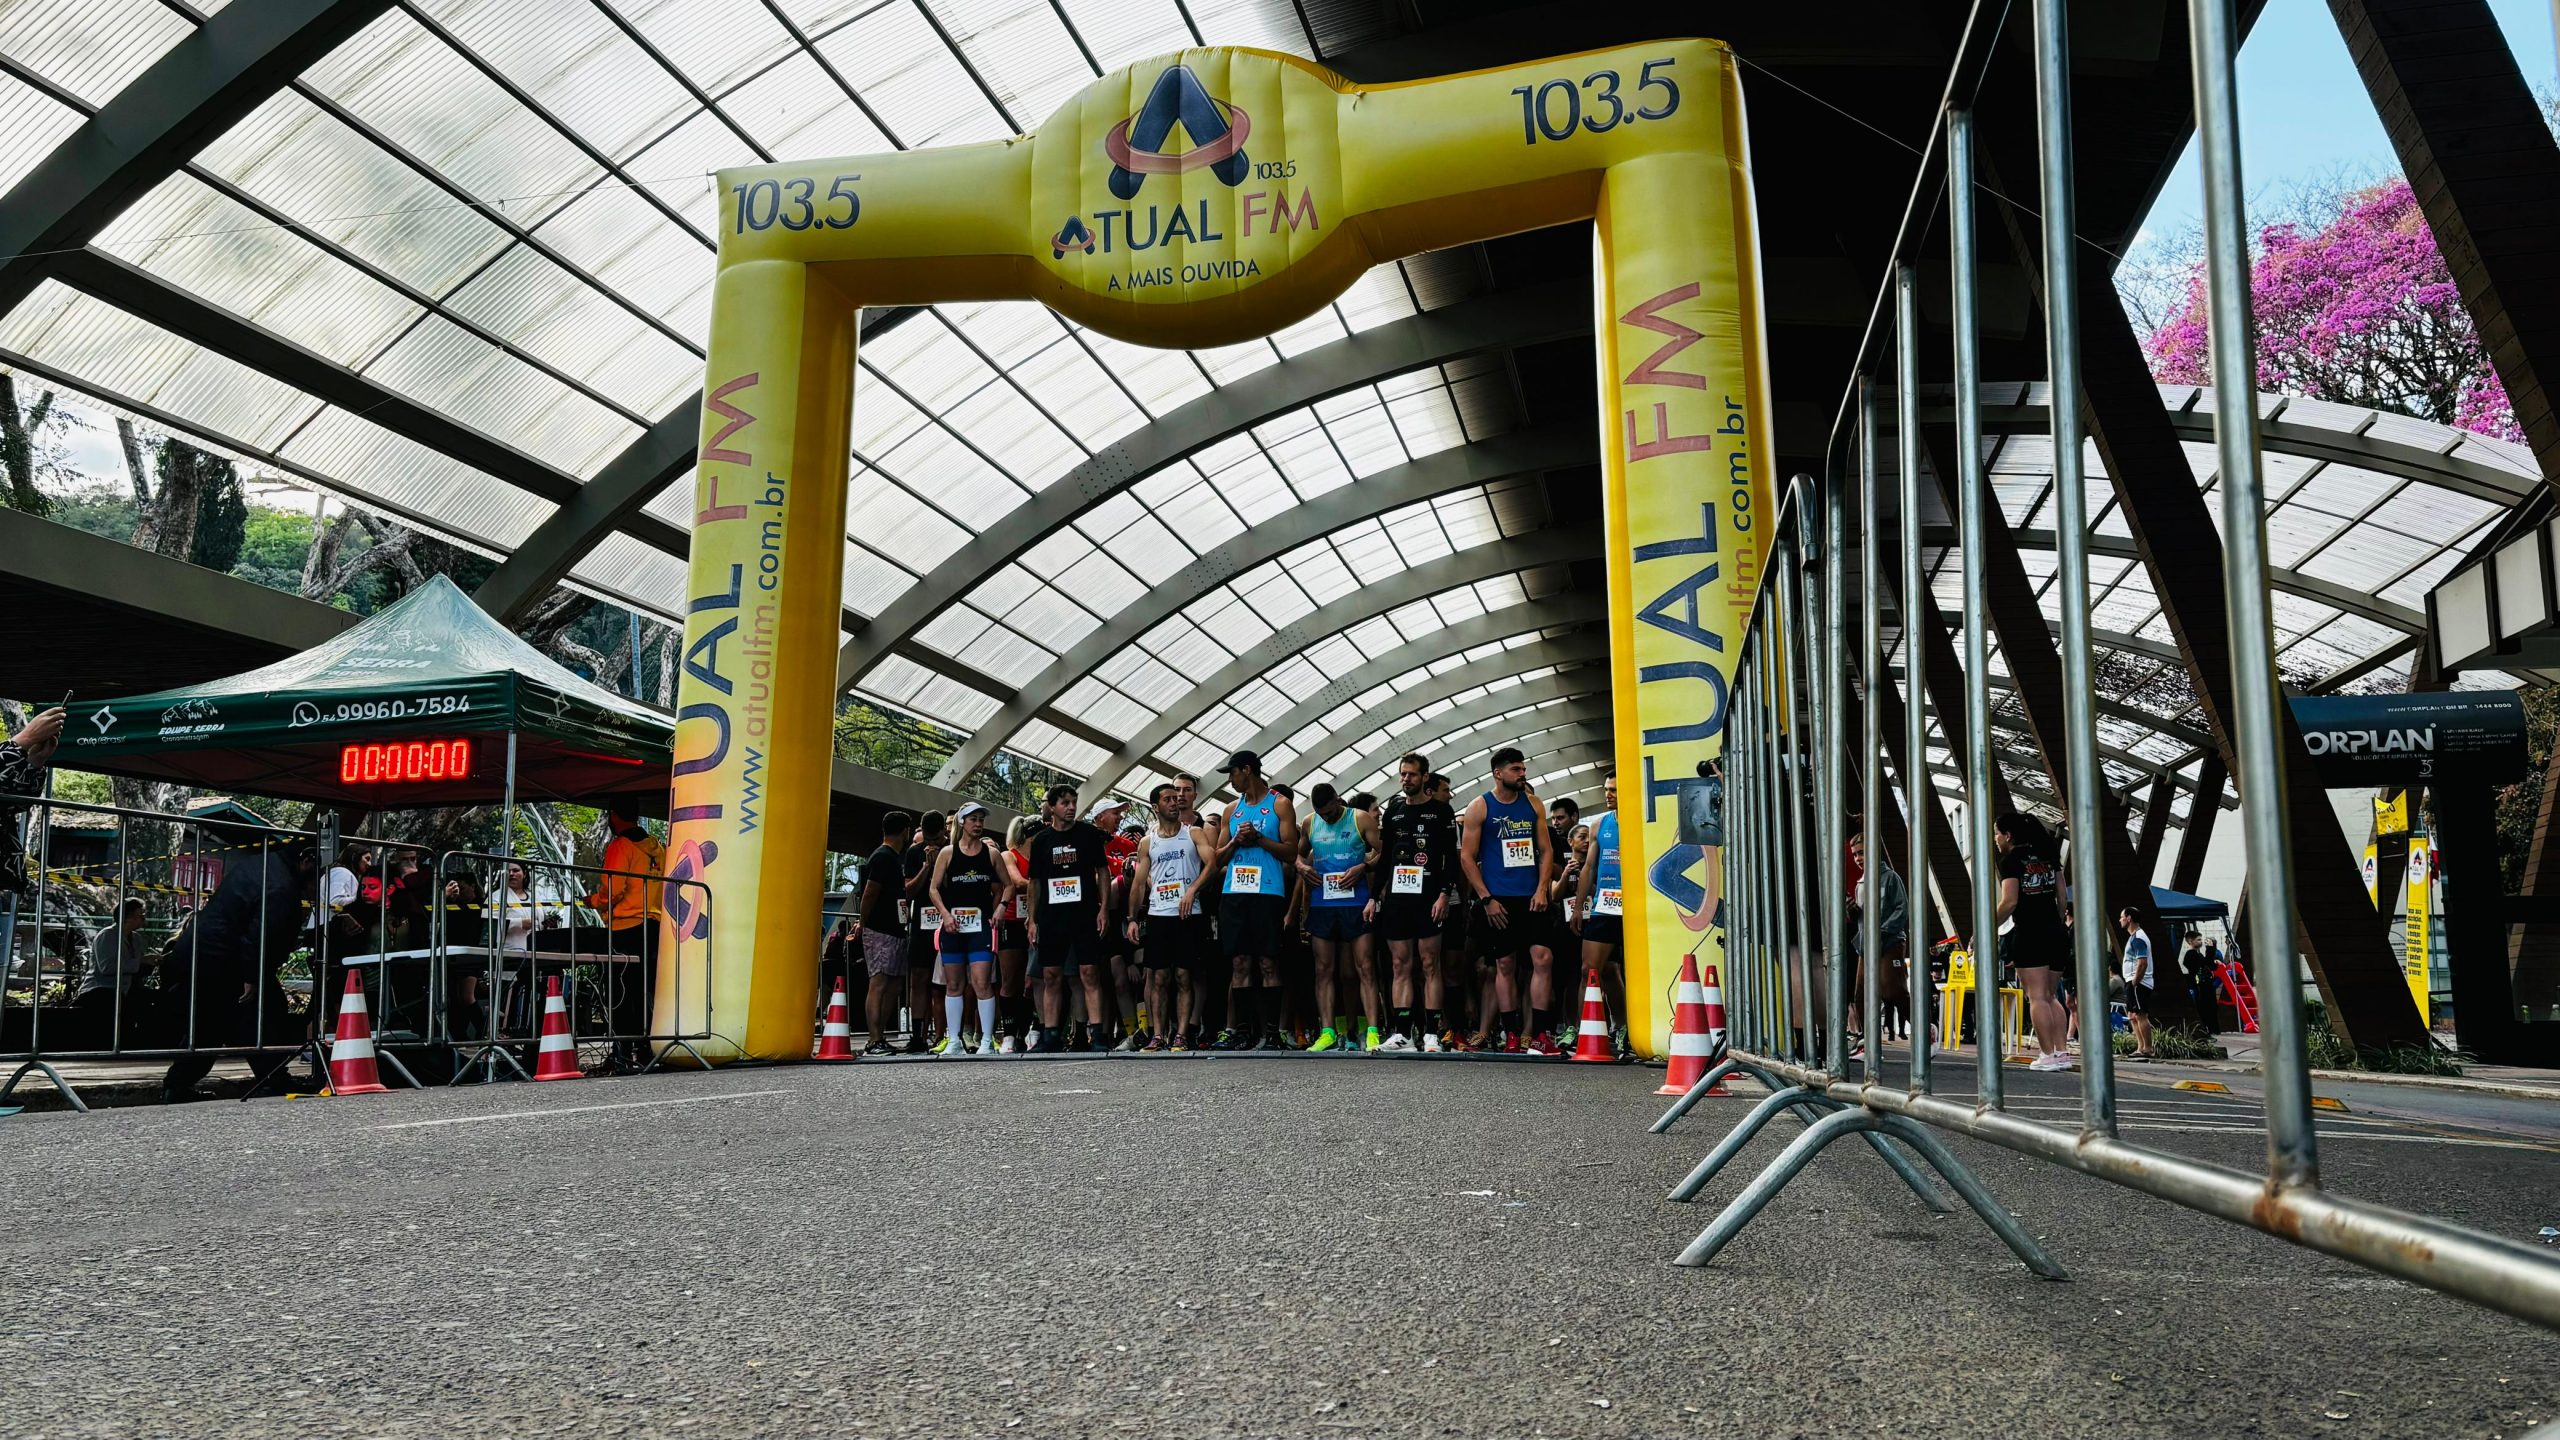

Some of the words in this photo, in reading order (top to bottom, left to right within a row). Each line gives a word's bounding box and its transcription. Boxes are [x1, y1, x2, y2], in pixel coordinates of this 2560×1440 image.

[1511, 57, 1681, 145] 103.5
[1253, 160, 1297, 180] 103.5
[732, 174, 862, 234] 103.5
[1243, 185, 1319, 238] FM
[1107, 273, 1122, 292] A
[1127, 267, 1173, 289] MAIS
[1181, 258, 1261, 284] OUVIDA
[1619, 281, 1711, 463] FM
[693, 372, 759, 528] FM
[338, 656, 432, 669] SERRA
[738, 471, 786, 835] www.atualfm.com.br
[337, 695, 470, 721] 99960-7584
[158, 726, 193, 735] EQUIPE
[193, 723, 225, 733] SERRA
[2302, 728, 2434, 757] ORPLAN
[342, 739, 469, 783] 00:00:00
[1510, 846, 1529, 858] 5112
[1055, 885, 1076, 896] 5094
[1236, 873, 1255, 884] 5015
[1397, 874, 1416, 884] 5316
[1160, 889, 1180, 901] 5234
[956, 914, 976, 926] 5217
